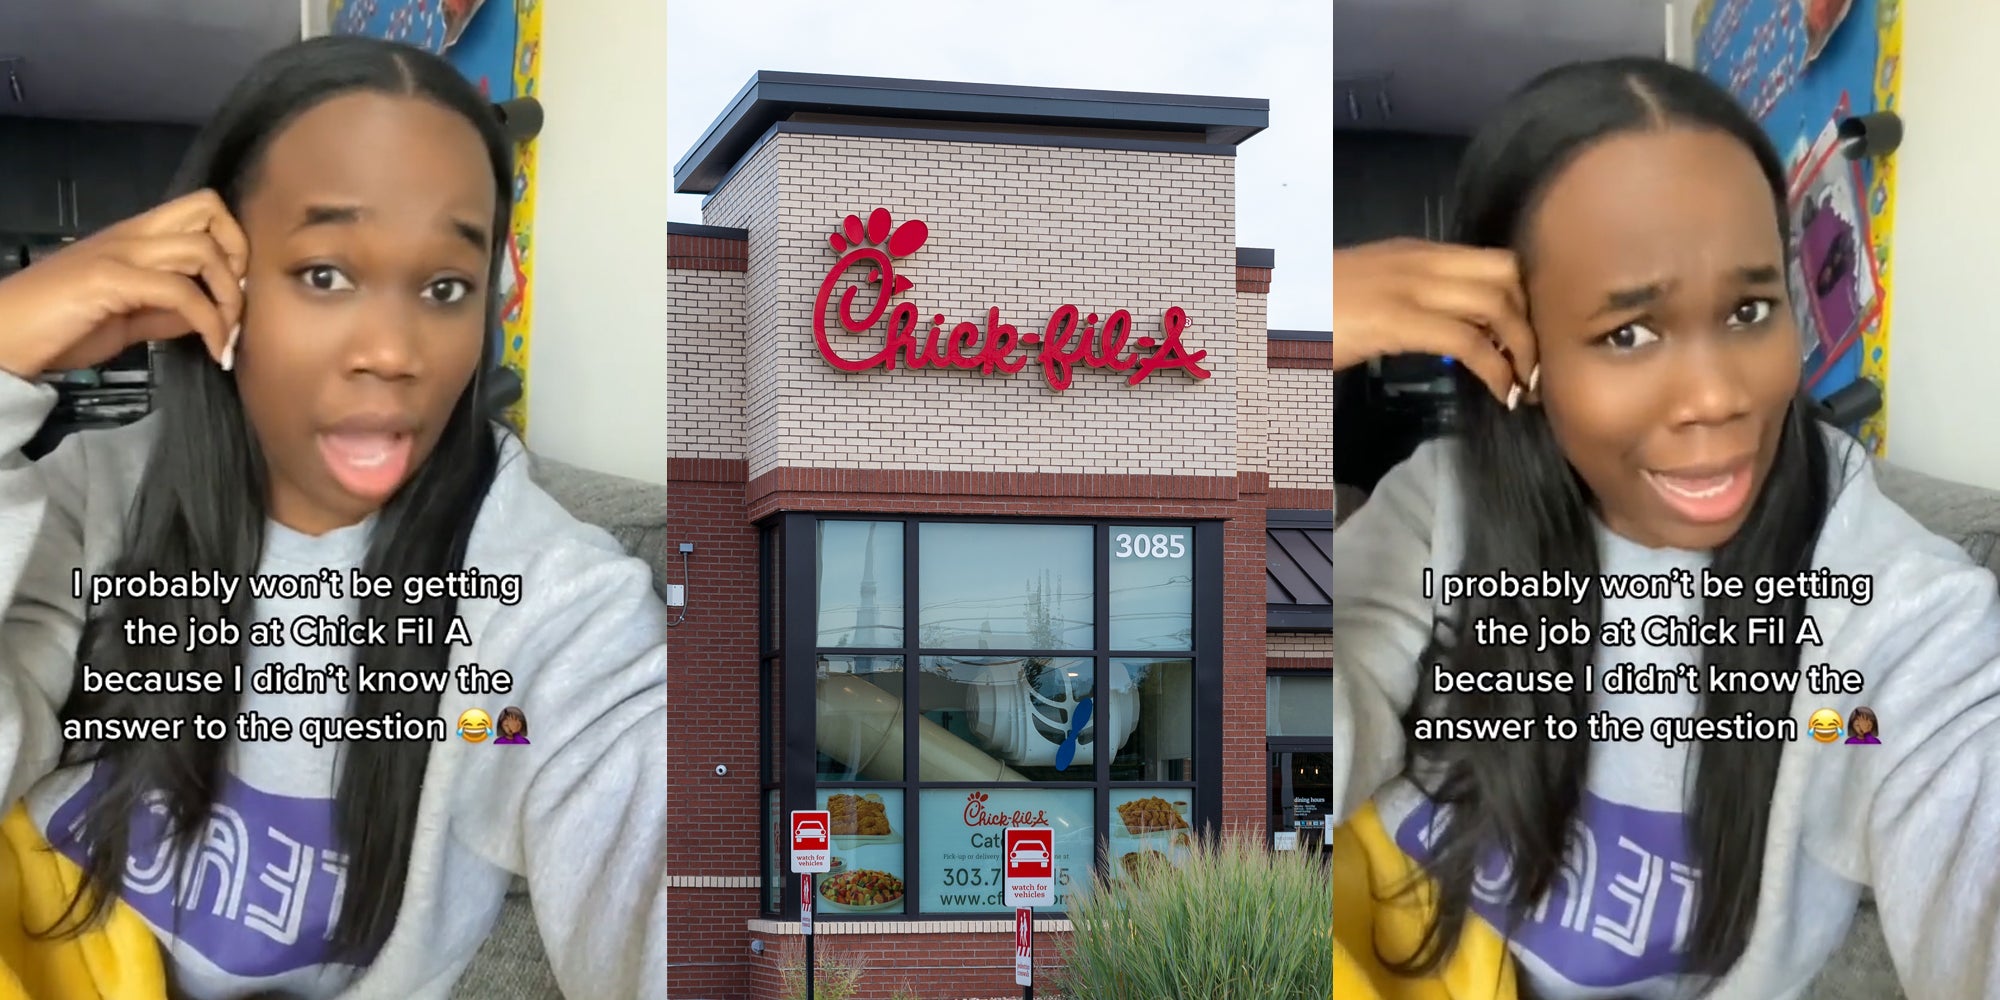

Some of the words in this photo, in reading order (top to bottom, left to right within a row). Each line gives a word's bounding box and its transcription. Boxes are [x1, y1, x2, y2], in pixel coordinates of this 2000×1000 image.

[813, 207, 1211, 392] Chick-fil-A
[1115, 533, 1185, 558] 3085
[964, 791, 1049, 828] Chick-fil-A
[943, 853, 967, 861] Pick-up
[975, 853, 1000, 861] delivery
[1011, 883, 1035, 891] watch
[1036, 883, 1048, 891] for
[1014, 890, 1046, 898] vehicles
